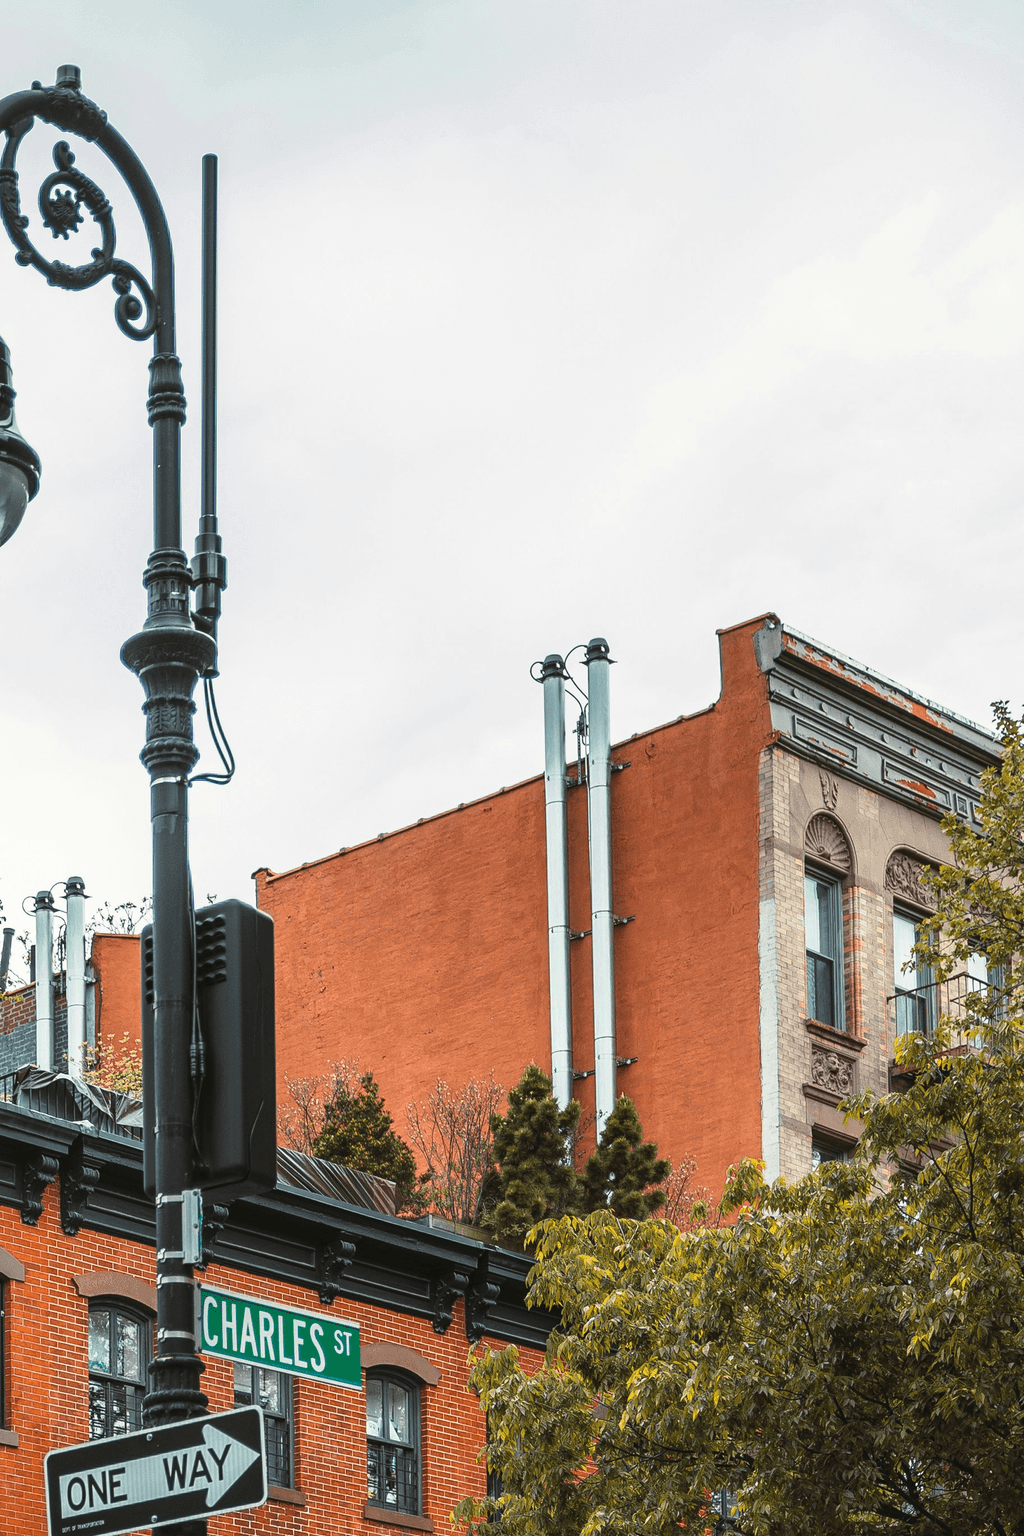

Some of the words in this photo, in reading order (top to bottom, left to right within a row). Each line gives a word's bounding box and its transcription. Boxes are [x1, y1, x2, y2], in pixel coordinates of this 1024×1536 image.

[203, 1295, 326, 1373] CHARLES
[333, 1329, 353, 1356] ST
[67, 1466, 128, 1512] ONE
[162, 1443, 232, 1492] WAY
